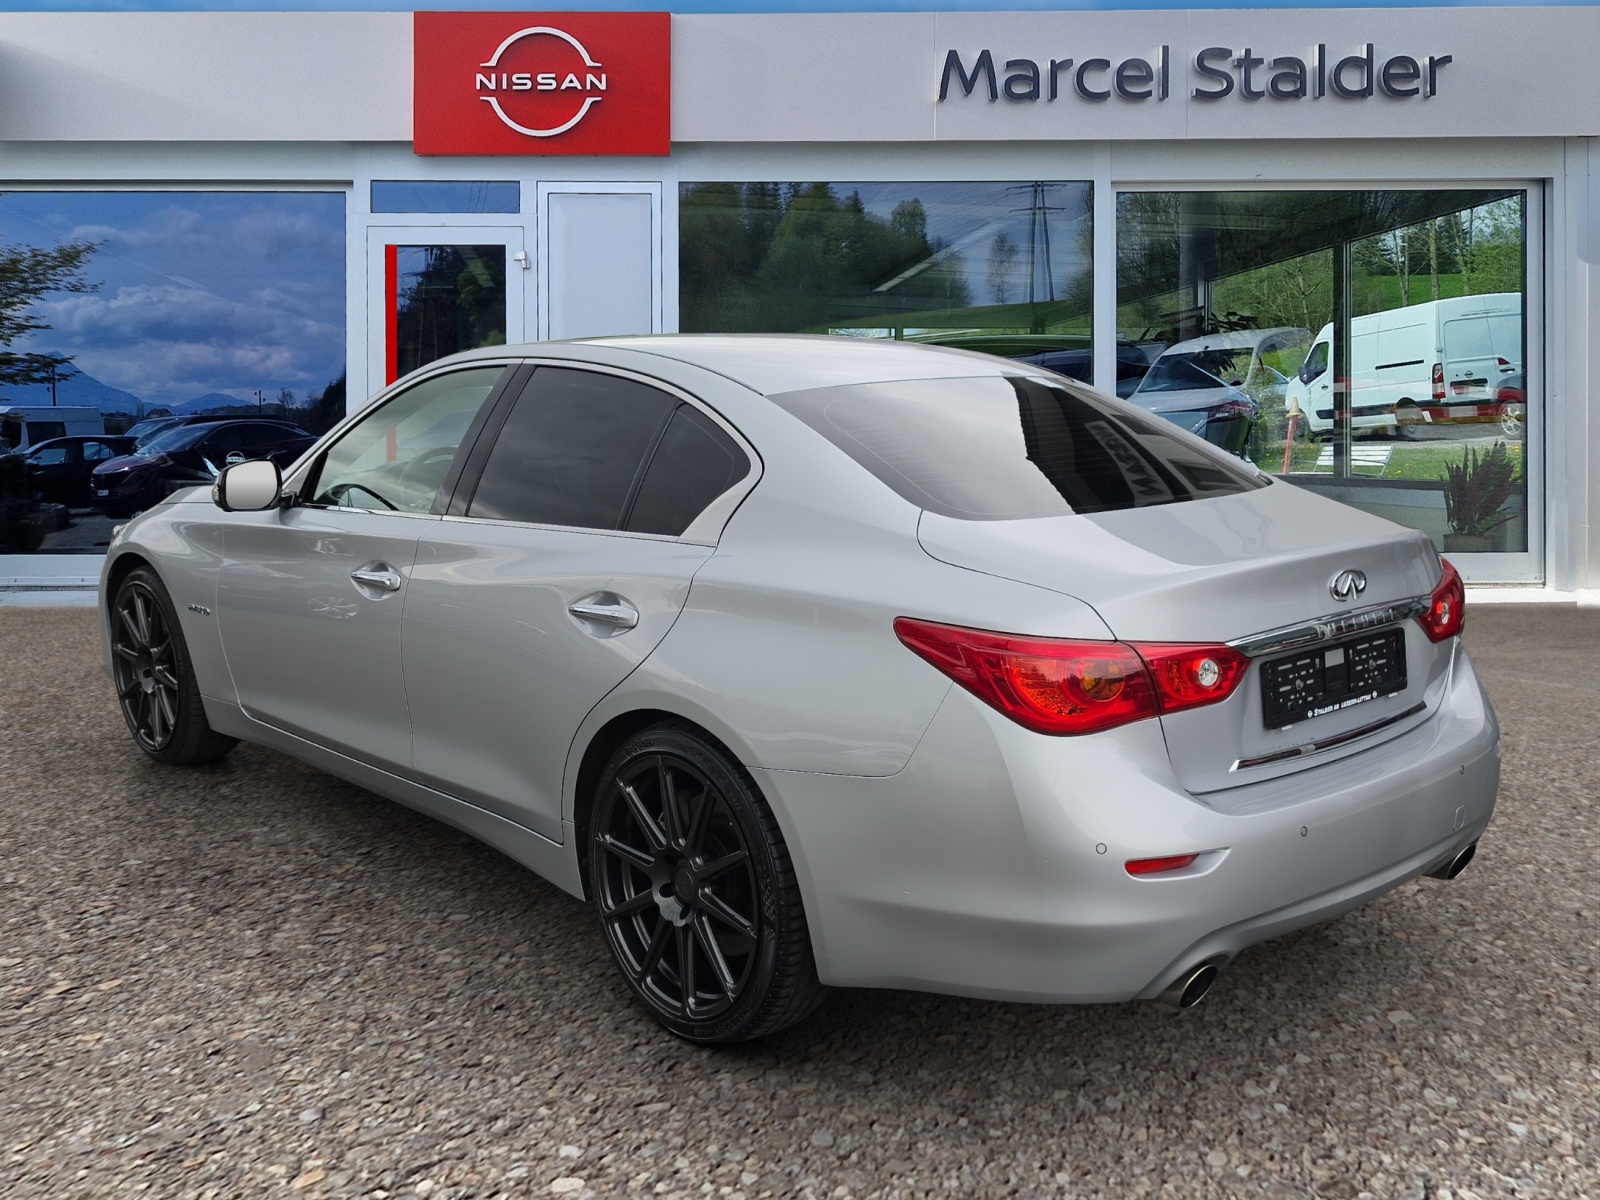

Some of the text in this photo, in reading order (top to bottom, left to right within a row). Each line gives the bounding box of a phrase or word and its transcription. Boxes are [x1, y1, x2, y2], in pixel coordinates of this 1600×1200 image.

[475, 73, 607, 91] NISSAN
[937, 43, 1453, 101] Marcel Stalder
